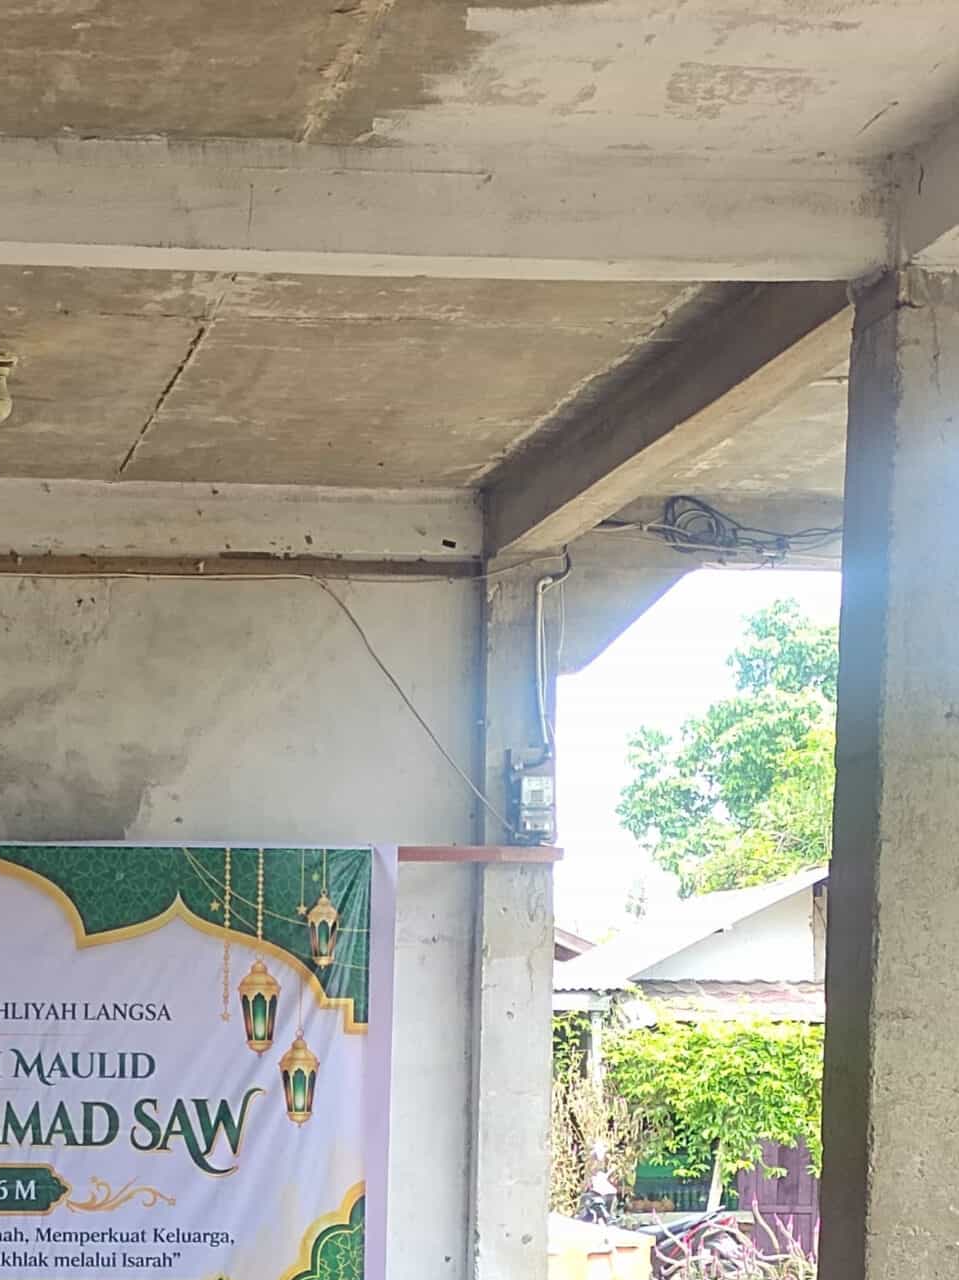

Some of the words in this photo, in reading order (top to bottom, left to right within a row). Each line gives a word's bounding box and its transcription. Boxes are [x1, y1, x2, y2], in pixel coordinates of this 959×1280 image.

[82, 1003, 172, 1021] LANGSA
[10, 1048, 156, 1086] MAULID
[130, 1086, 264, 1175] SAW
[15, 1180, 36, 1200] M
[35, 1228, 146, 1245] Memperkuat
[153, 1229, 235, 1247] Keluarga,
[54, 1252, 117, 1268] melalui
